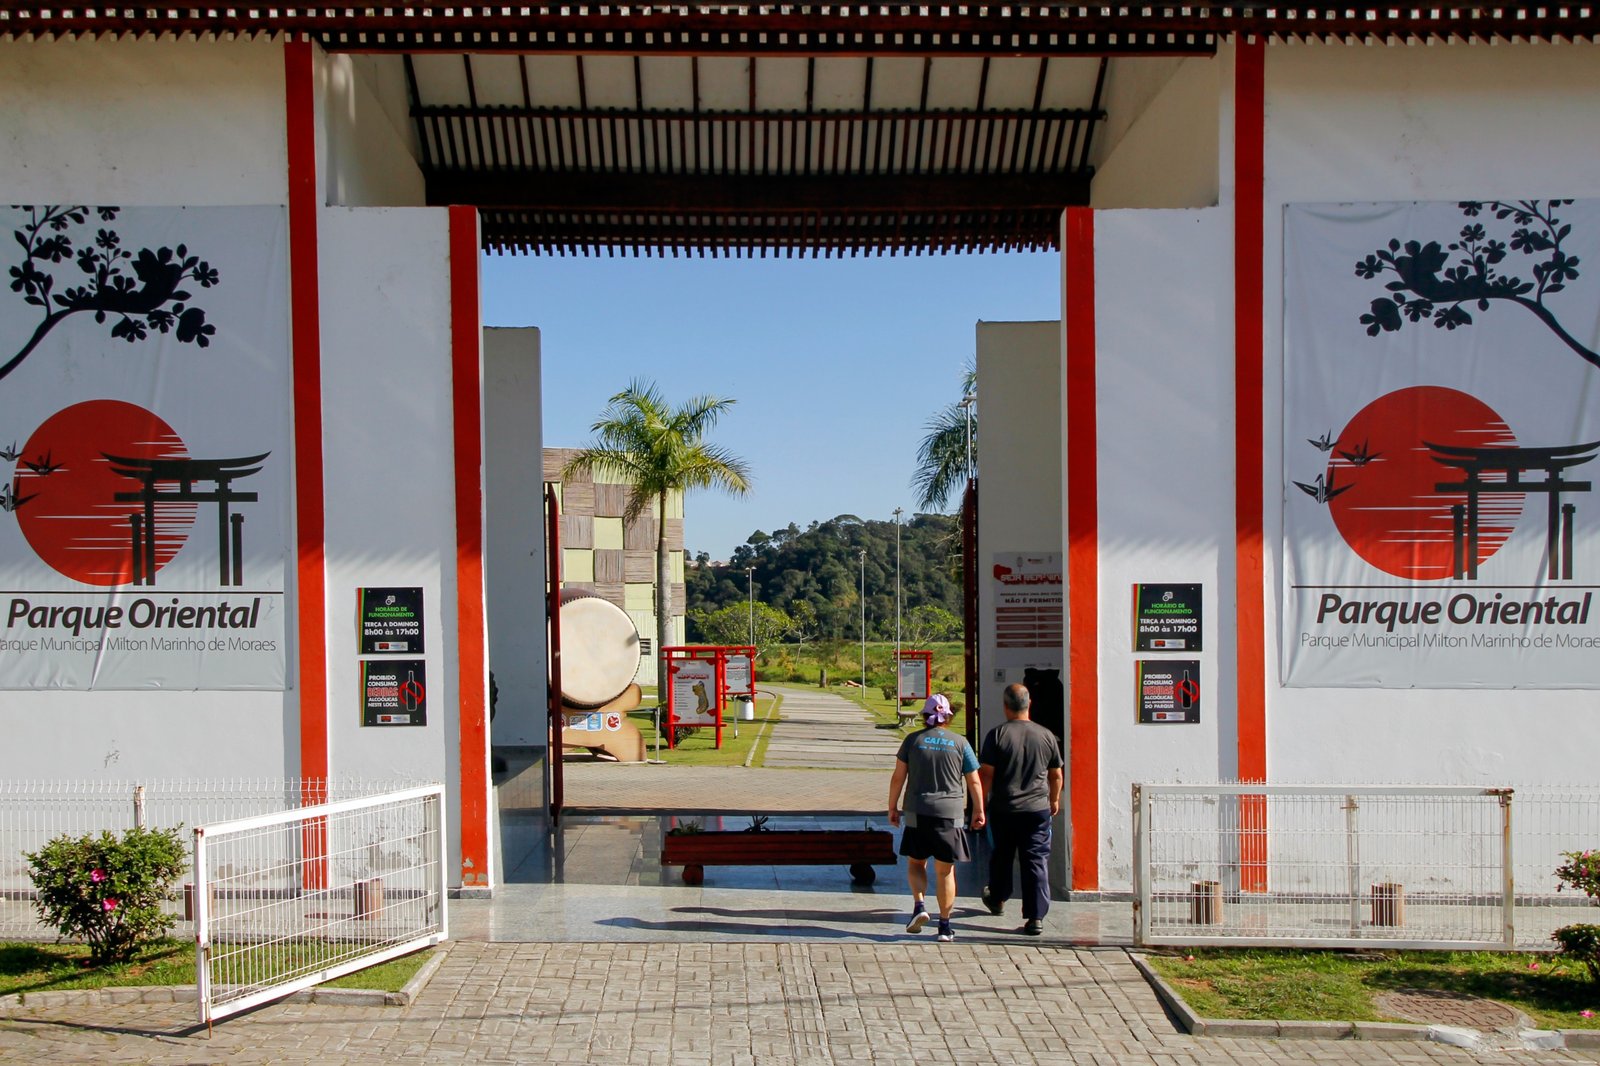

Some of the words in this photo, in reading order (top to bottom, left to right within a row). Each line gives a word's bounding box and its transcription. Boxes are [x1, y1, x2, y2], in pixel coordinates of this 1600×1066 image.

[7, 599, 124, 636] Parque
[128, 597, 261, 629] Oriental
[1317, 593, 1442, 632] Parque
[1447, 592, 1592, 625] Oriental
[0, 637, 38, 653] arque
[41, 637, 103, 654] Municipal
[106, 637, 148, 651] Milton
[150, 637, 206, 651] Marinho
[208, 637, 226, 651] de
[228, 637, 276, 651] Moraes
[1301, 633, 1349, 649] Parque
[1352, 632, 1420, 650] Municipal
[1423, 632, 1468, 648] Milton
[1471, 633, 1531, 648] Marinho
[1533, 633, 1553, 648] de
[1555, 633, 1600, 648] Morae
[923, 736, 955, 747] CAIXA
